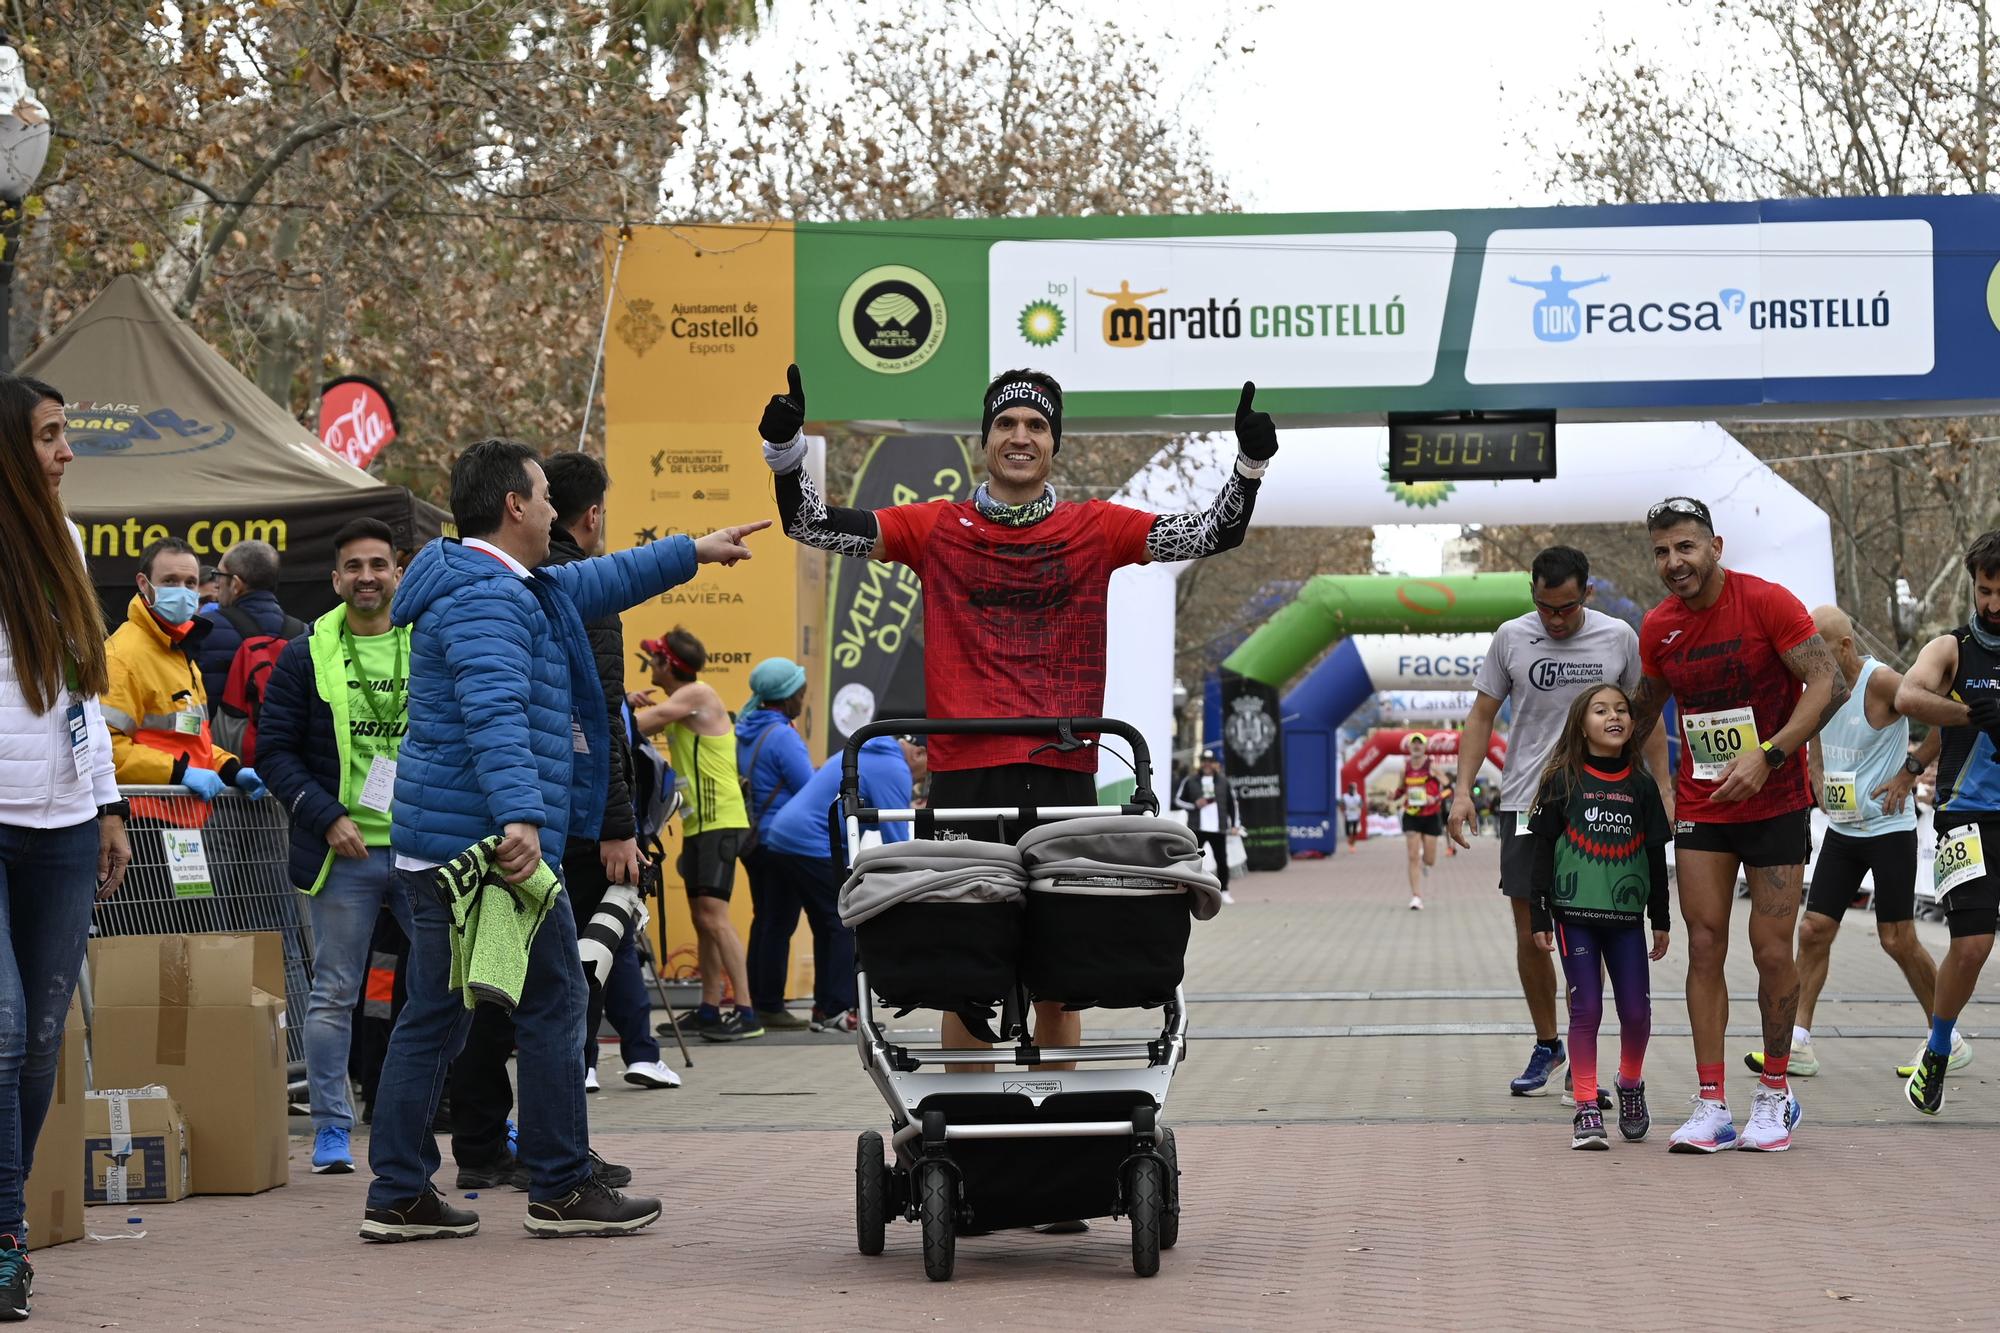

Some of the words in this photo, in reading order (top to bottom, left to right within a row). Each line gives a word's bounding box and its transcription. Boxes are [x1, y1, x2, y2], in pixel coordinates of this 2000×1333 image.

[1047, 280, 1068, 295] bp
[671, 302, 737, 317] Ajuntament
[743, 301, 758, 313] de
[1540, 305, 1575, 335] 10K
[1749, 290, 1890, 330] CASTELLÓ
[1109, 298, 1241, 342] marató
[1250, 294, 1406, 338] CASTELLÓ
[671, 315, 759, 339] Castelló
[876, 330, 910, 338] WORLD
[689, 341, 736, 356] Esports
[868, 338, 918, 347] ATHLETICS
[1002, 381, 1033, 393] RUN
[991, 388, 1055, 417] ADDICTION
[66, 417, 131, 432] ante
[1402, 431, 1546, 467] 3:00:17
[666, 455, 723, 464] COMUNITAT
[670, 464, 683, 473] DE
[660, 592, 745, 604] BAVIERA
[1700, 727, 1742, 754] 160
[1711, 752, 1737, 762] TONO
[1826, 785, 1847, 804] 292
[1584, 806, 1633, 825] Urban
[1588, 822, 1632, 837] running
[1938, 841, 1967, 874] 338
